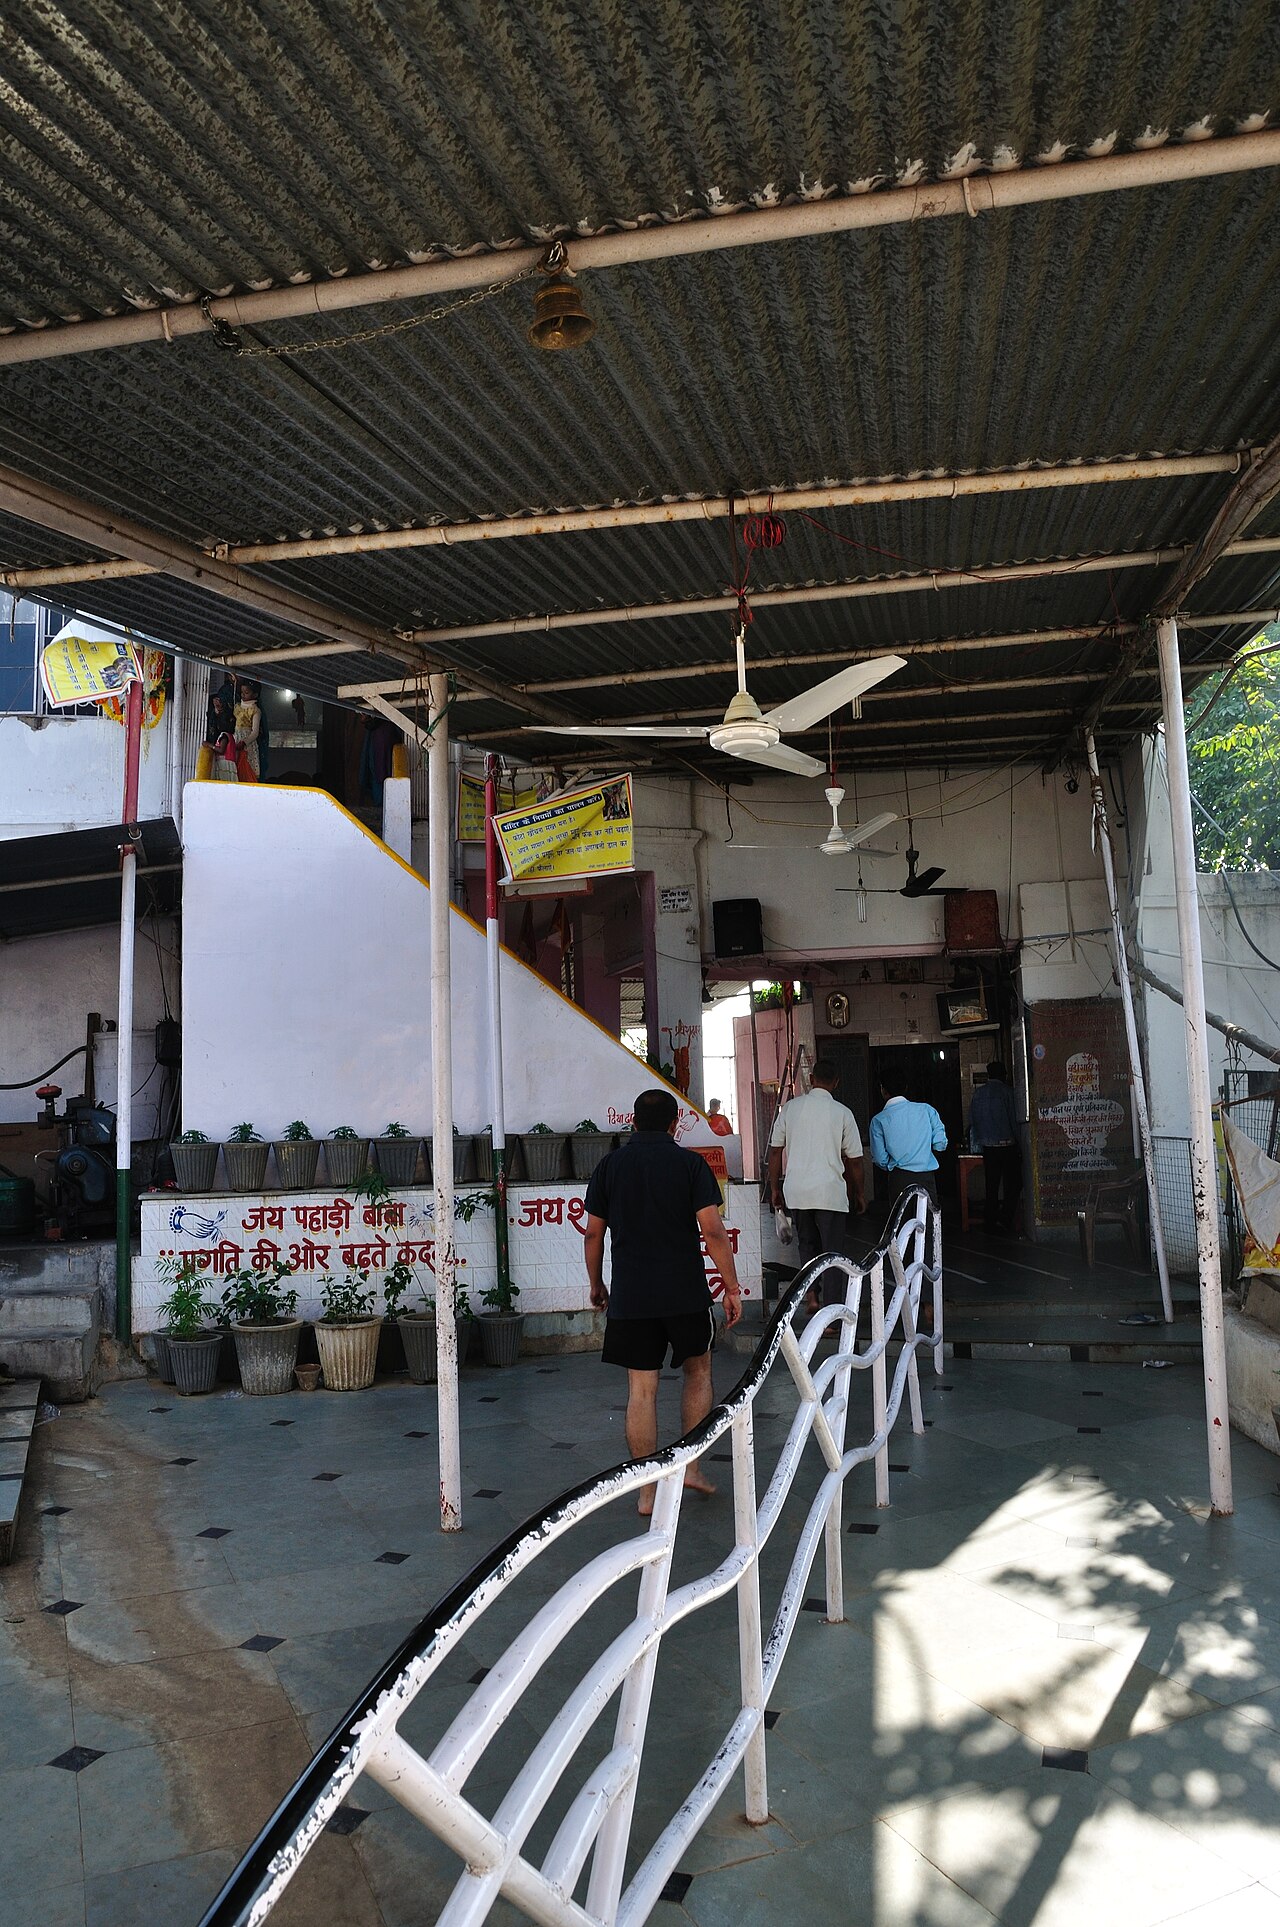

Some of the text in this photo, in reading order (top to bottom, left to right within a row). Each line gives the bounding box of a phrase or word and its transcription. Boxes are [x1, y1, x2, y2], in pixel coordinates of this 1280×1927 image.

[503, 822, 520, 832] मंदिर
[521, 817, 531, 826] के
[532, 810, 552, 823] नियमों
[554, 806, 565, 815] का
[567, 801, 585, 812] पालन
[241, 1205, 287, 1233] जय
[518, 1197, 566, 1228] जय
[286, 1237, 332, 1272] ओर
